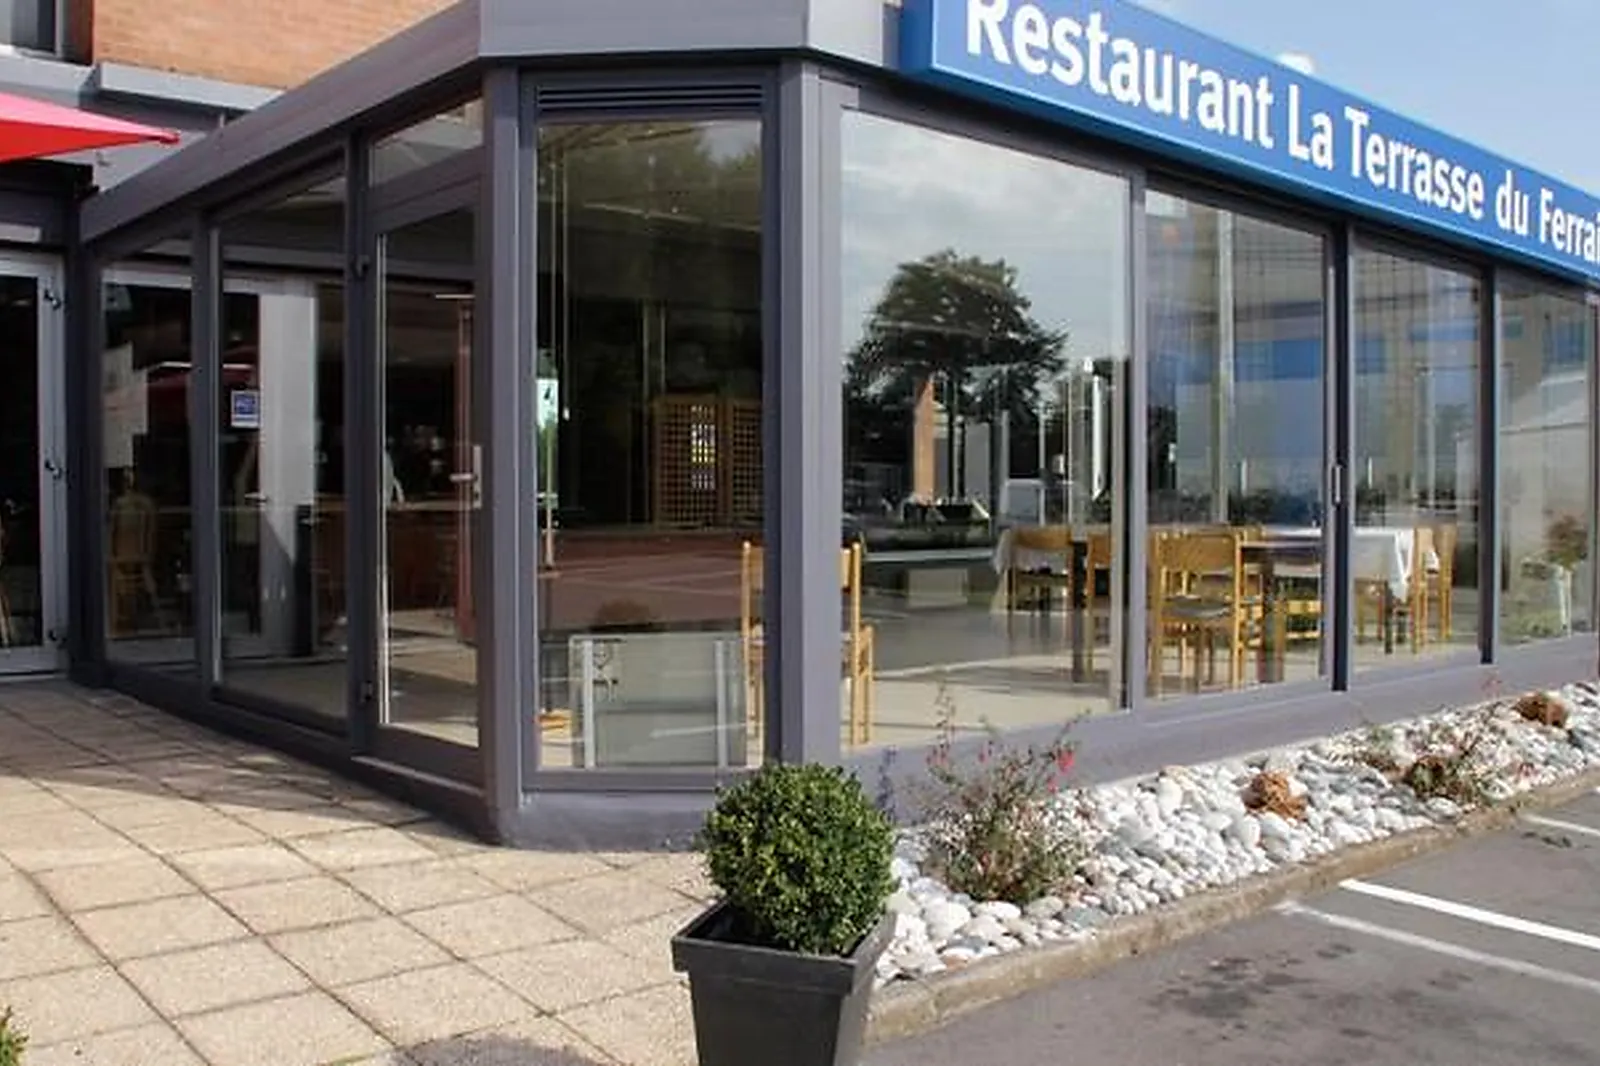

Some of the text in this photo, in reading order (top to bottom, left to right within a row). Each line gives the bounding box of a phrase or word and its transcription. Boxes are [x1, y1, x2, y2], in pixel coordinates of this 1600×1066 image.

[966, 0, 1274, 149] Restaurant
[1288, 84, 1333, 170] La
[1345, 107, 1484, 219] Terrasse
[1495, 170, 1529, 236] du
